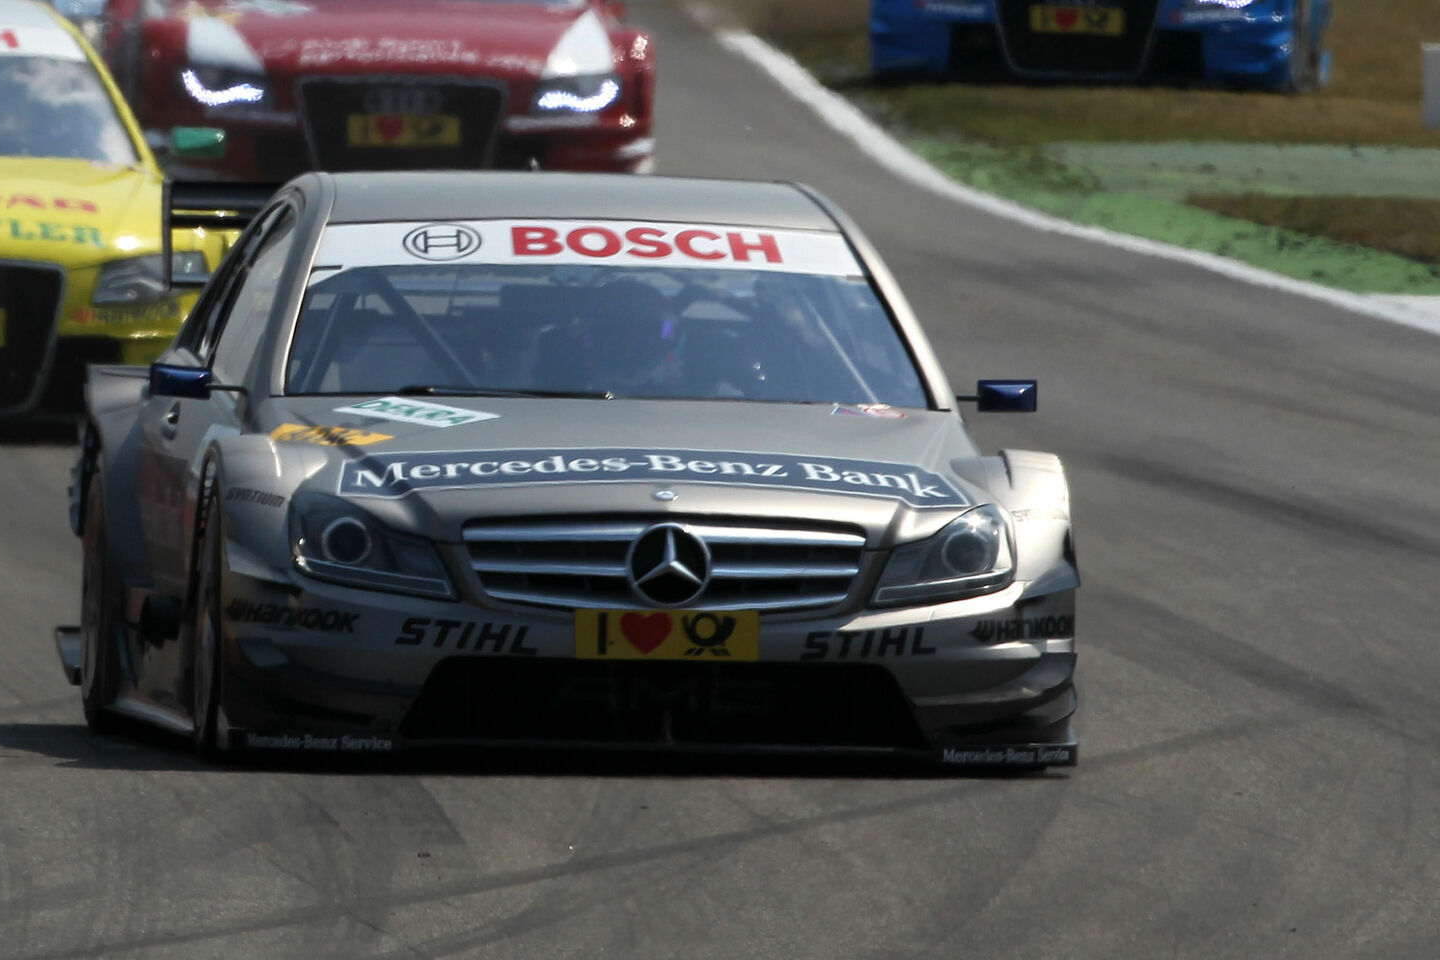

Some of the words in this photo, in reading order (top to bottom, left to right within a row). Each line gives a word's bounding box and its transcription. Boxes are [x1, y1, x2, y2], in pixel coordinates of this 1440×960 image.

[511, 226, 782, 263] BOSCH
[354, 454, 787, 488] Mercedes-Benz
[803, 462, 951, 499] Bank
[395, 617, 538, 656] STIHL
[801, 626, 936, 660] STIHL
[340, 734, 393, 751] Service
